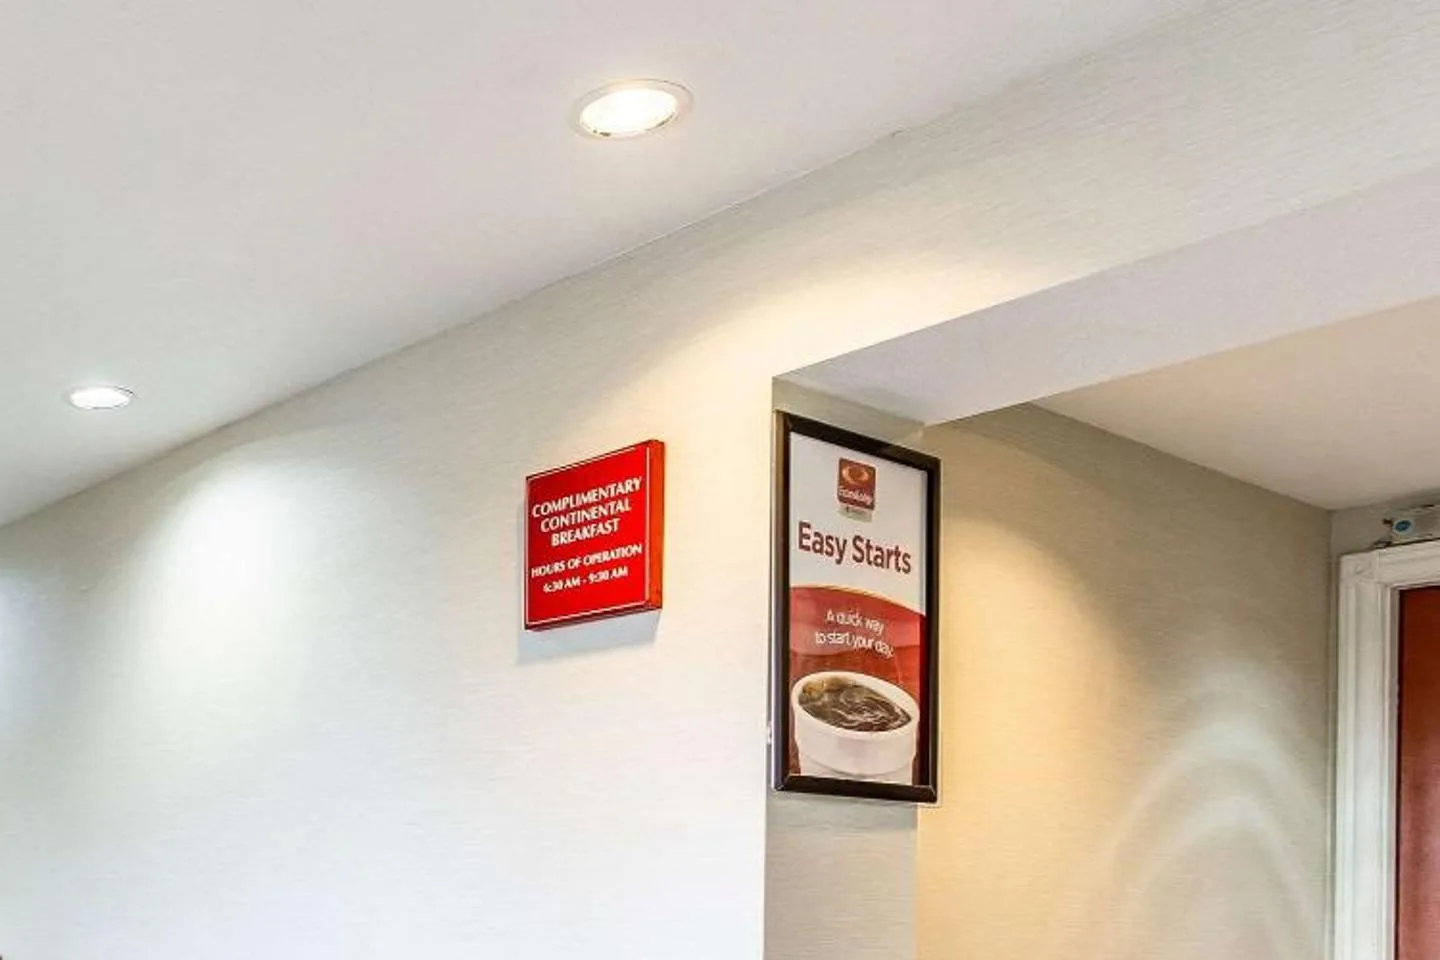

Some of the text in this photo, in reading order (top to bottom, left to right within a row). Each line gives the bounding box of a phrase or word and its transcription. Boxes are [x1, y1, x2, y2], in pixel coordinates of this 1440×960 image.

[531, 476, 642, 518] COMPLIMENTARY
[540, 498, 632, 533] CONTINENTAL
[551, 518, 621, 547] BREAKFAST
[798, 520, 912, 574] Easy Starts
[531, 543, 643, 578] HOURS OF OPERATION
[564, 575, 581, 589] AM
[610, 565, 629, 579] AM
[826, 608, 884, 637] A quick way
[815, 631, 826, 644] to
[827, 631, 850, 646] start
[851, 634, 874, 651] your
